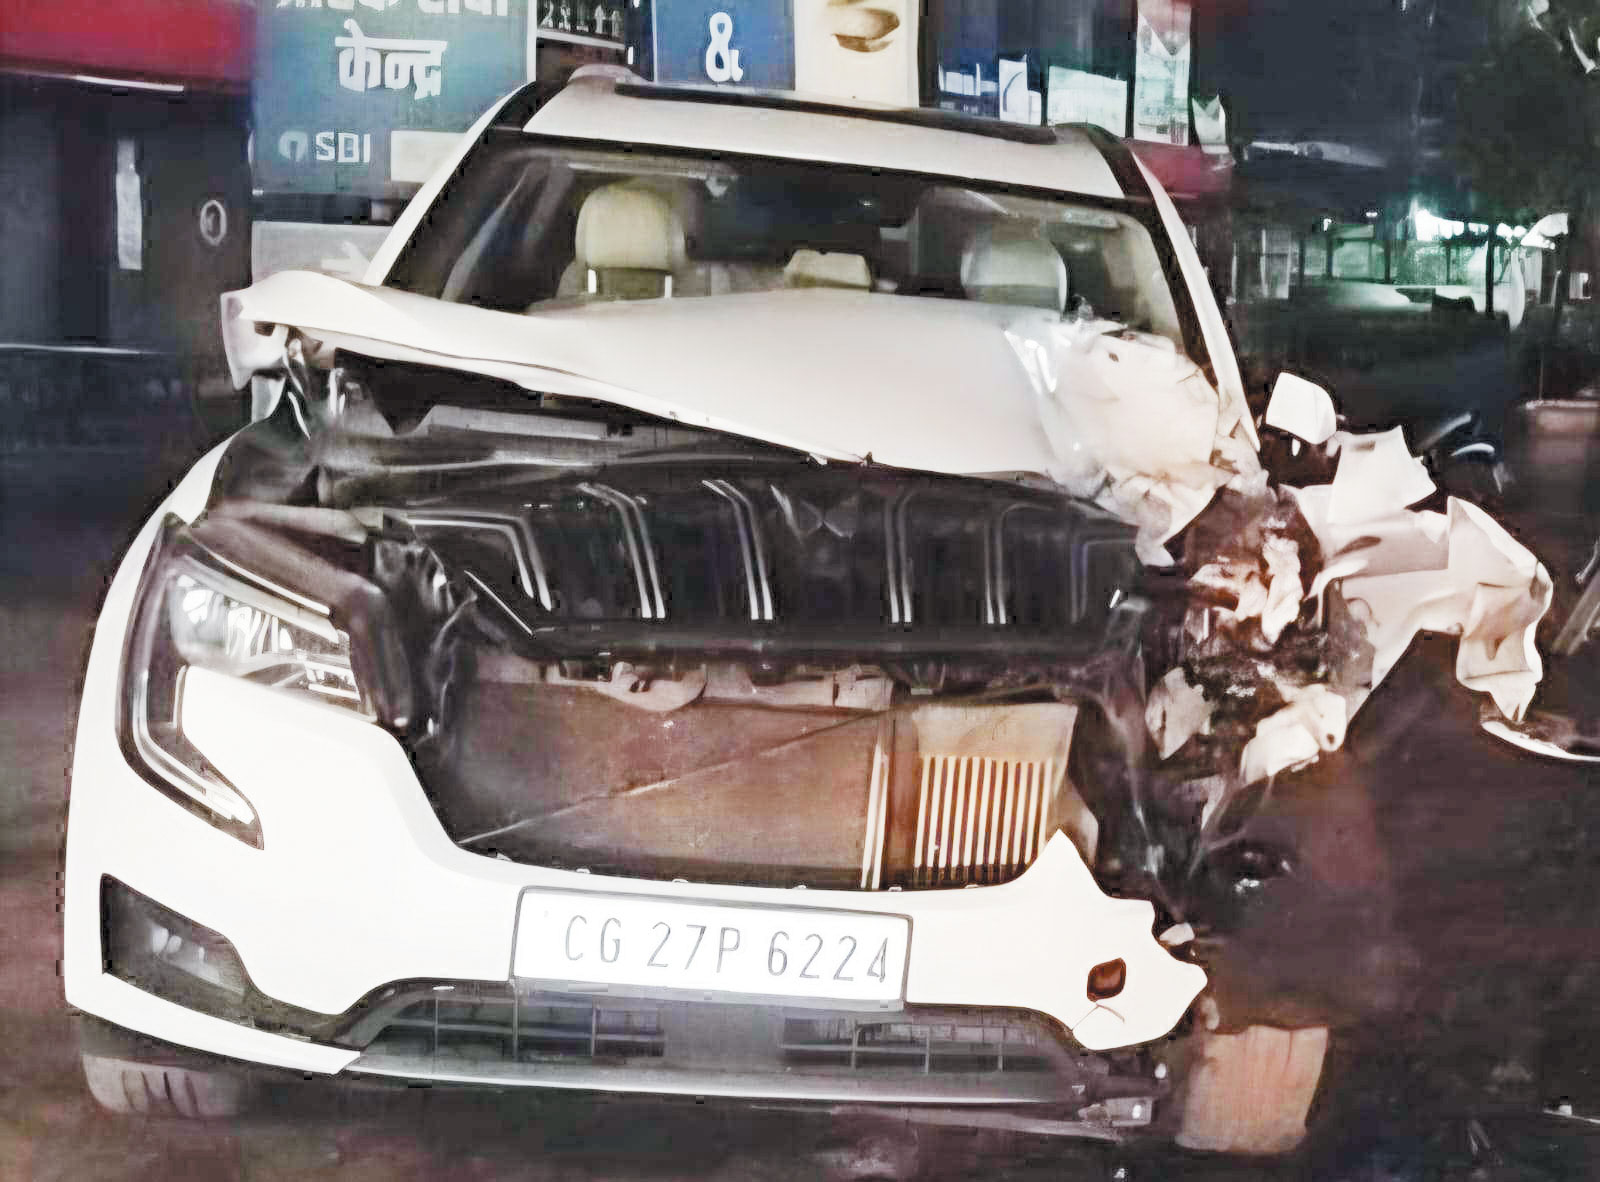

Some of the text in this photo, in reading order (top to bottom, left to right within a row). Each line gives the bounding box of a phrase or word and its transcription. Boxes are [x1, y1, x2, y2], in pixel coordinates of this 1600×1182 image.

[705, 11, 744, 82] &
[564, 914, 890, 984] CG 27P 6224
